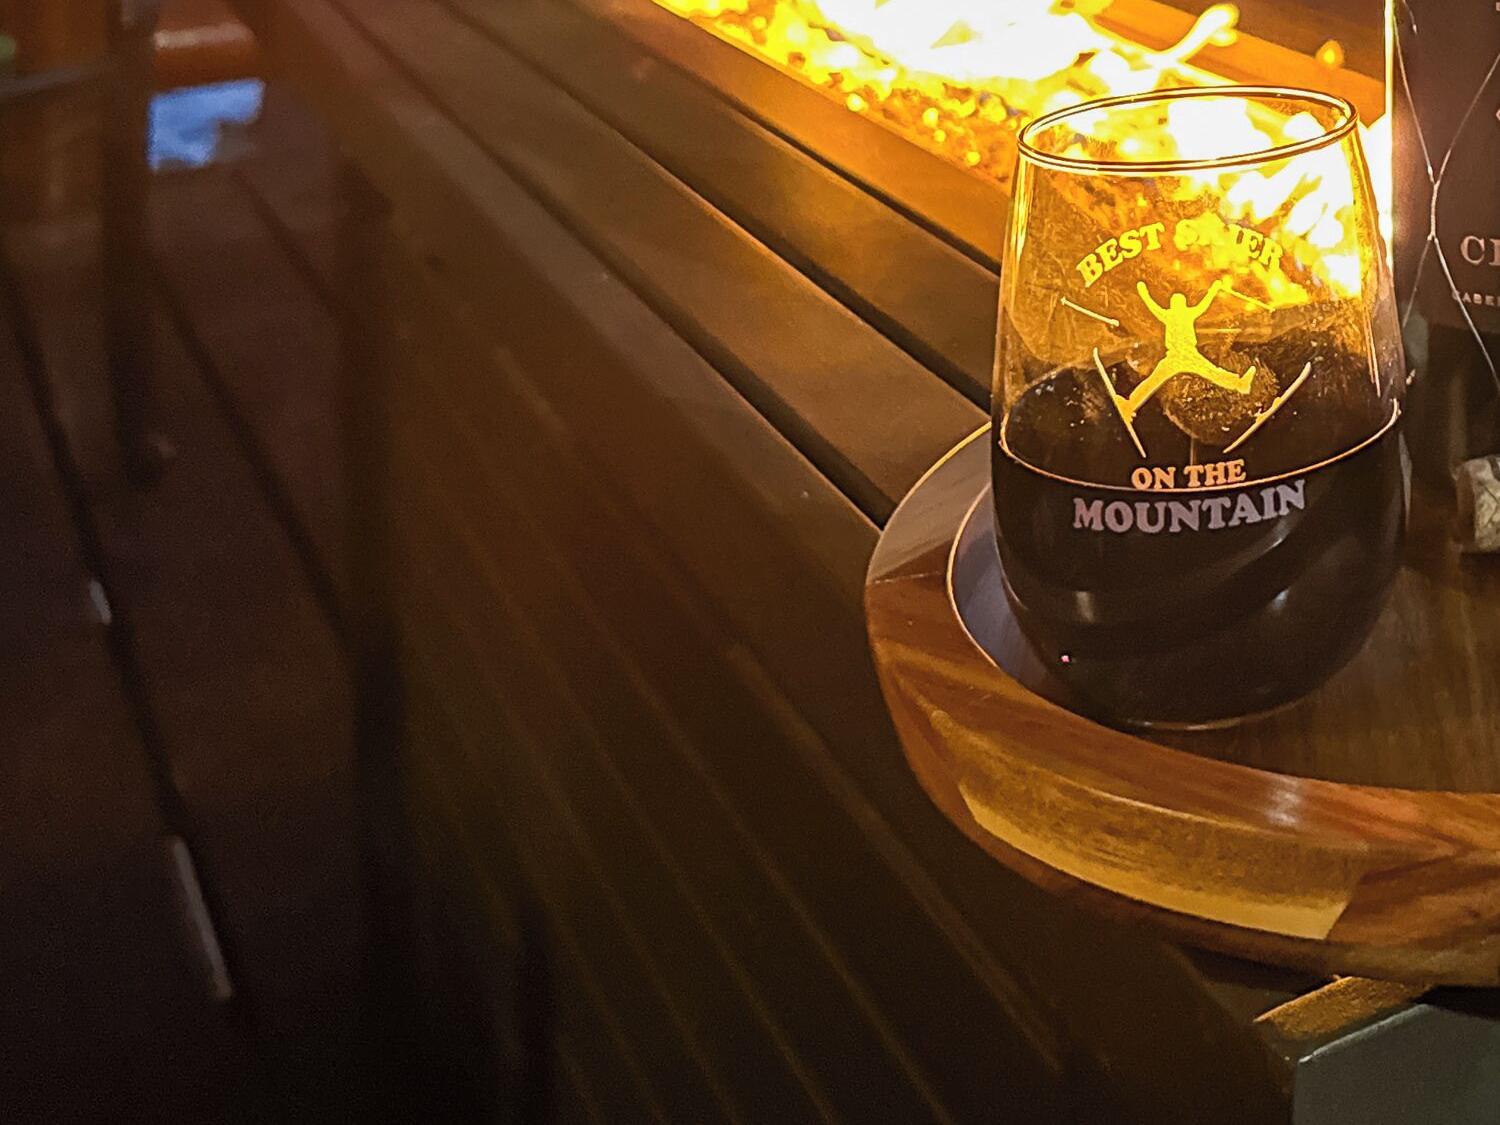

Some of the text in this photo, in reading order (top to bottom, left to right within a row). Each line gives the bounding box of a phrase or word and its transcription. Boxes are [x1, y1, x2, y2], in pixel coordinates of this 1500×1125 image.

[1076, 218, 1284, 288] BEST SIER
[1131, 459, 1246, 490] ON THE
[1072, 479, 1306, 533] MOUNTAIN
